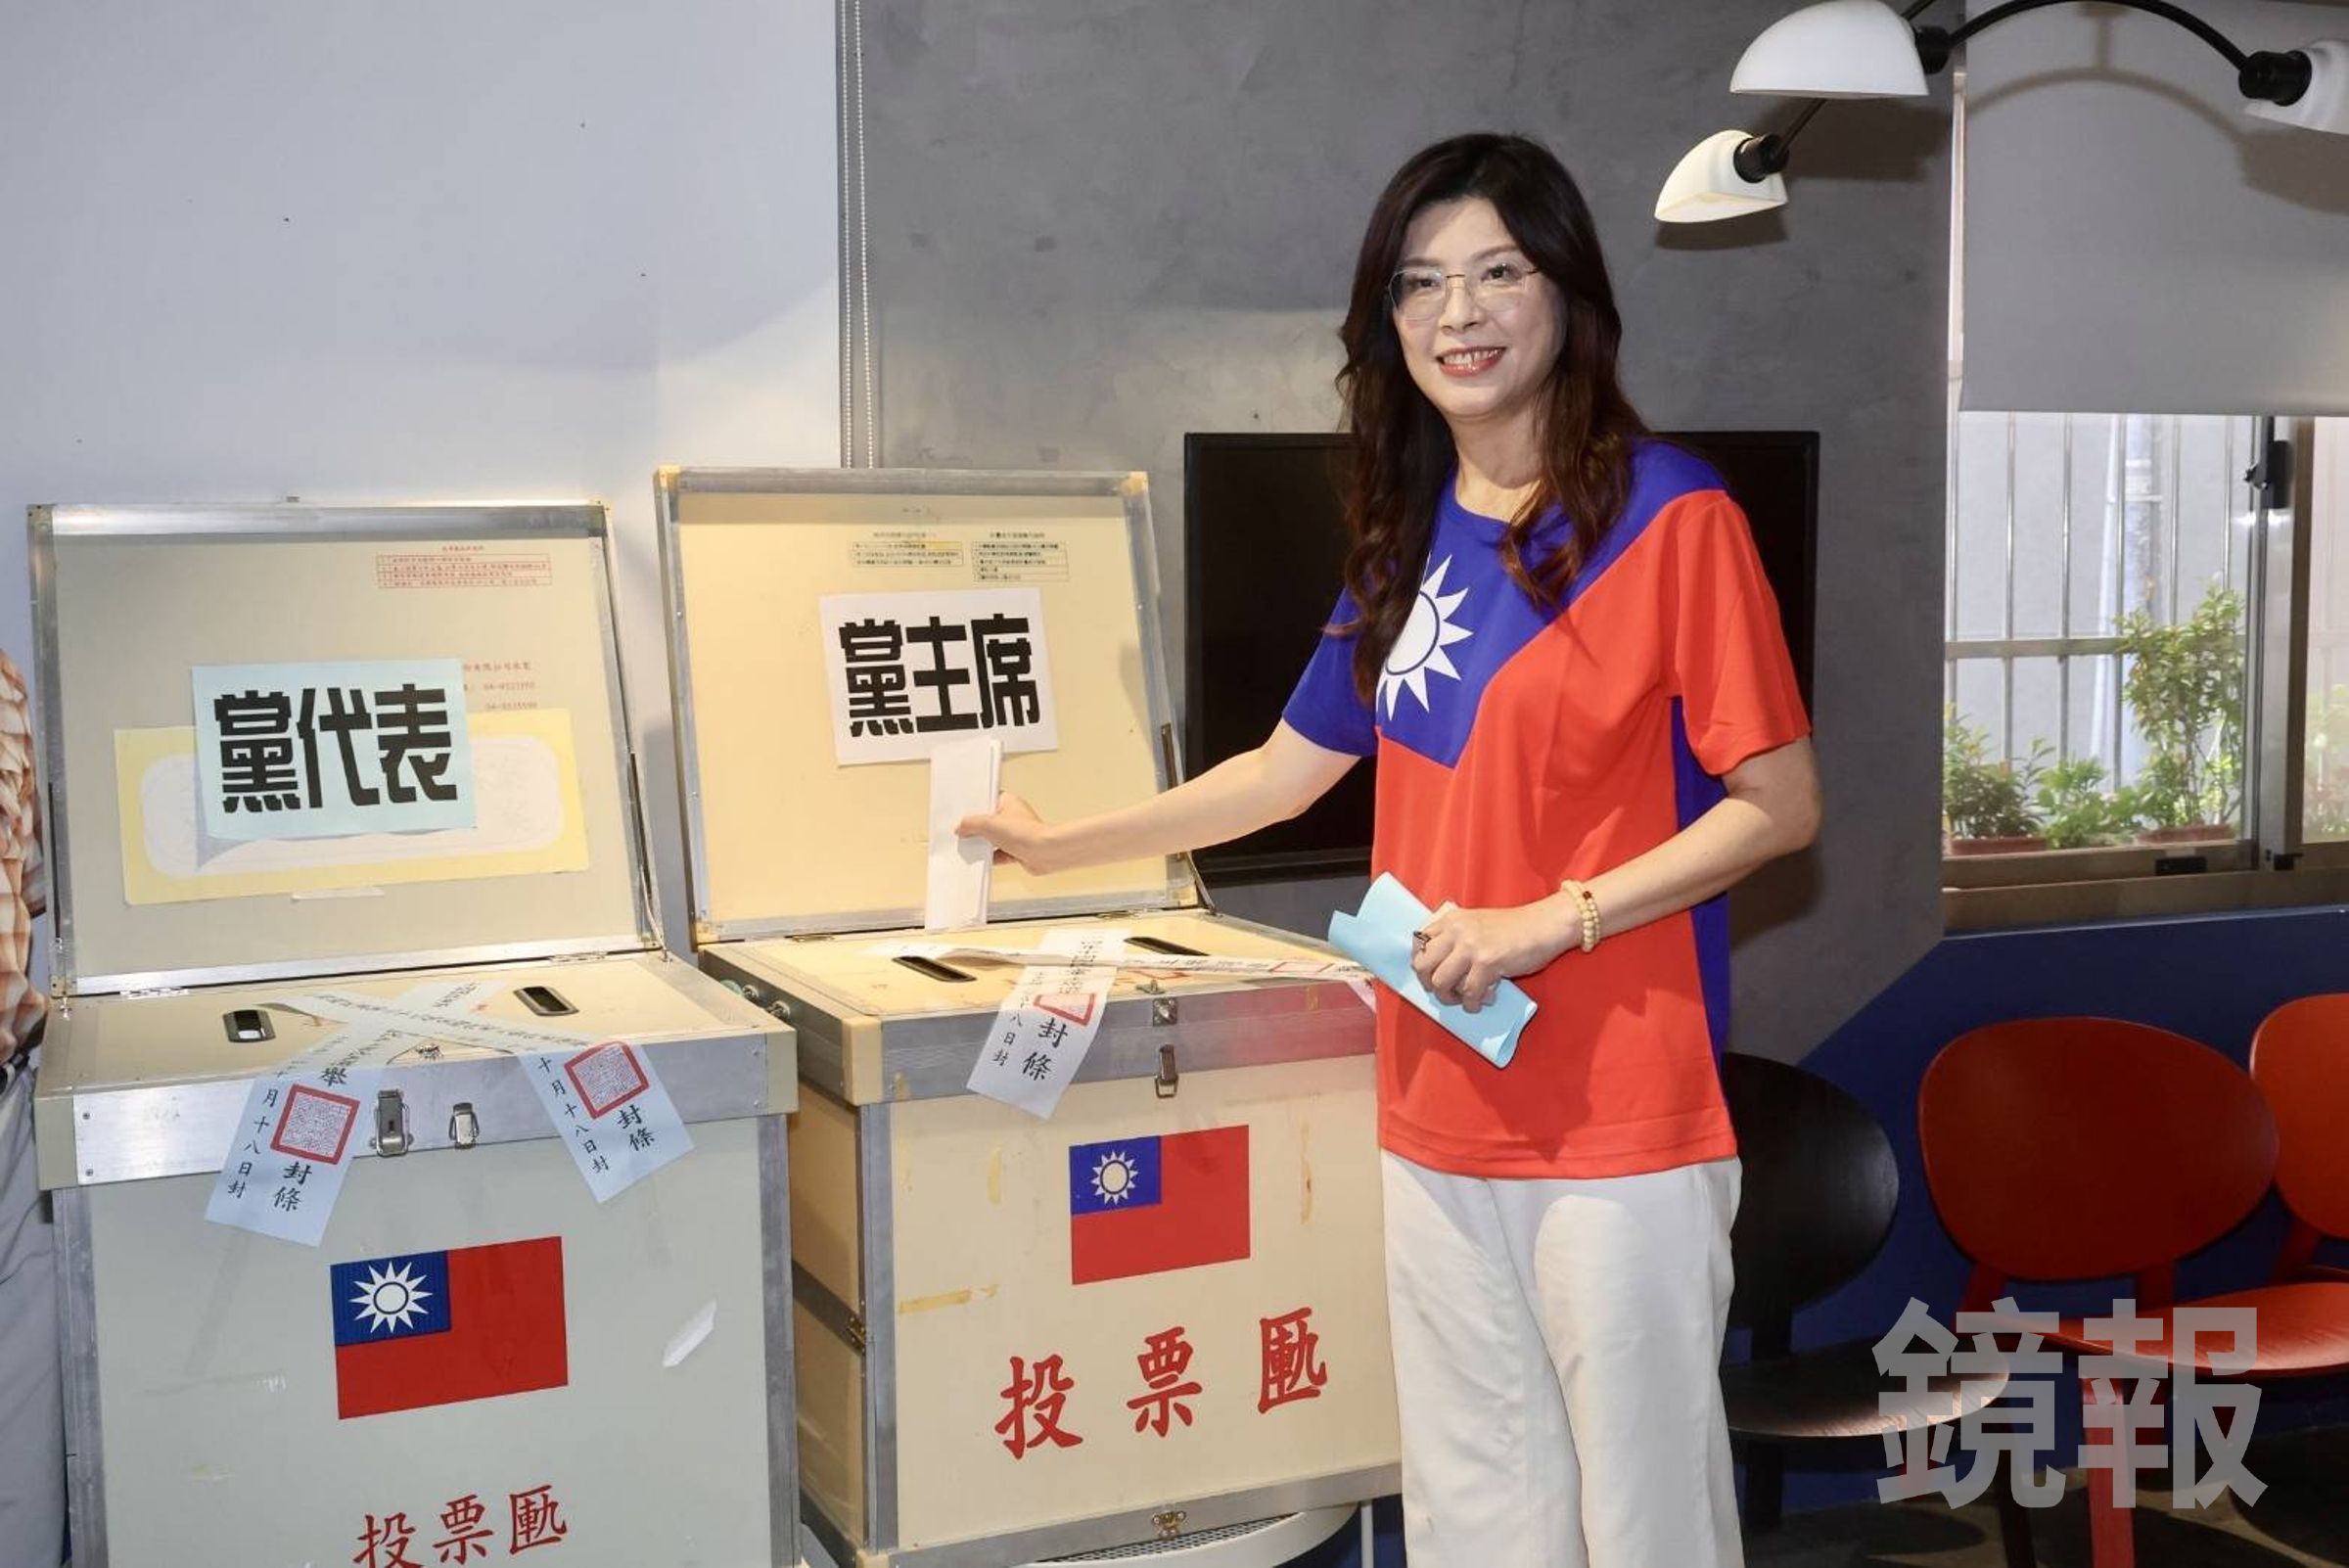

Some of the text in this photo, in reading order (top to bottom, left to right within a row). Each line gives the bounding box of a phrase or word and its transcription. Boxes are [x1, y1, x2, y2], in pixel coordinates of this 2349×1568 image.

[839, 613, 1041, 737] 黨主席
[213, 682, 458, 813] 黨代表
[1021, 1017, 1069, 1082] 封條
[537, 1056, 610, 1174] 十月十八日封
[616, 1103, 658, 1152] 封條
[273, 1161, 313, 1213] 封條
[993, 1307, 1328, 1460] 投票匭
[352, 1484, 568, 1568] 投票匭
